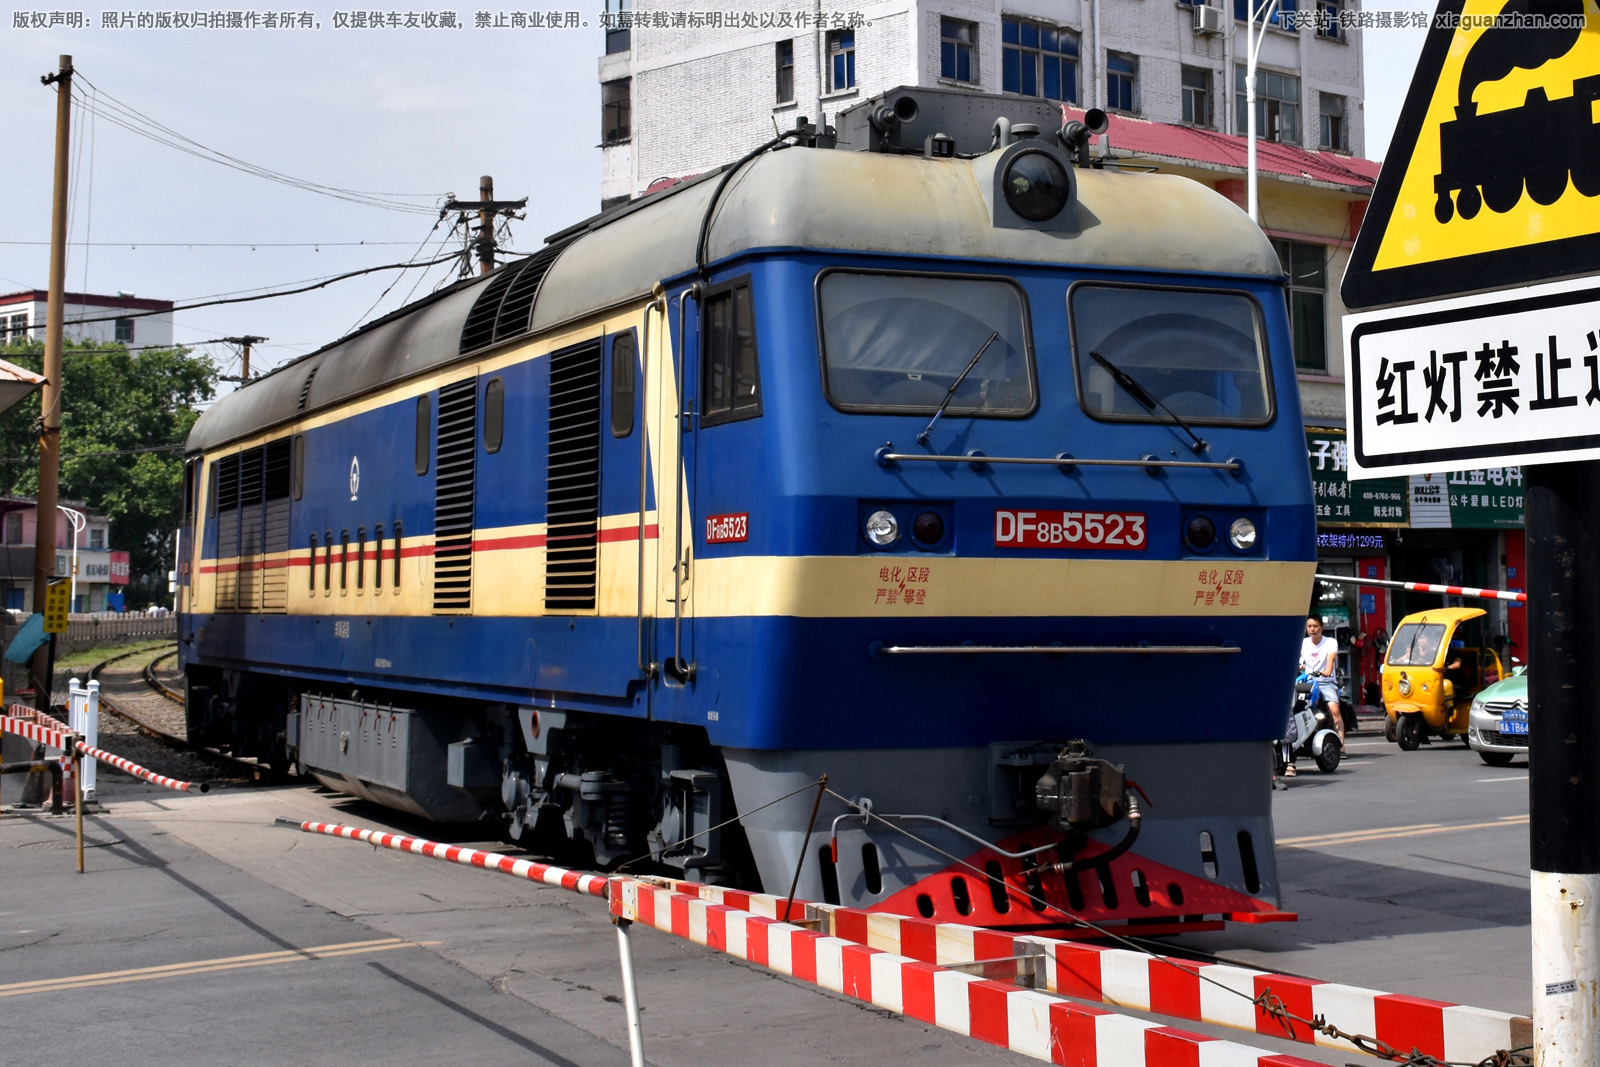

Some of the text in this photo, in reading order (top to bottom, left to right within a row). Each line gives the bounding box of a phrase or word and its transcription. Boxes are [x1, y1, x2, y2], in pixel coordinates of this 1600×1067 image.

[1308, 440, 1347, 471] 子弹
[1450, 494, 1523, 508] 公牛爱眼LED灯
[1336, 504, 1351, 516] 工具
[1373, 506, 1402, 518] 阳光灯饰
[996, 511, 1145, 546] DF8B5523
[879, 566, 930, 582] 电化区段
[1198, 569, 1244, 585] 电化区段
[874, 588, 926, 605] 严禁攀登
[1193, 590, 1240, 606] 严禁攀登
